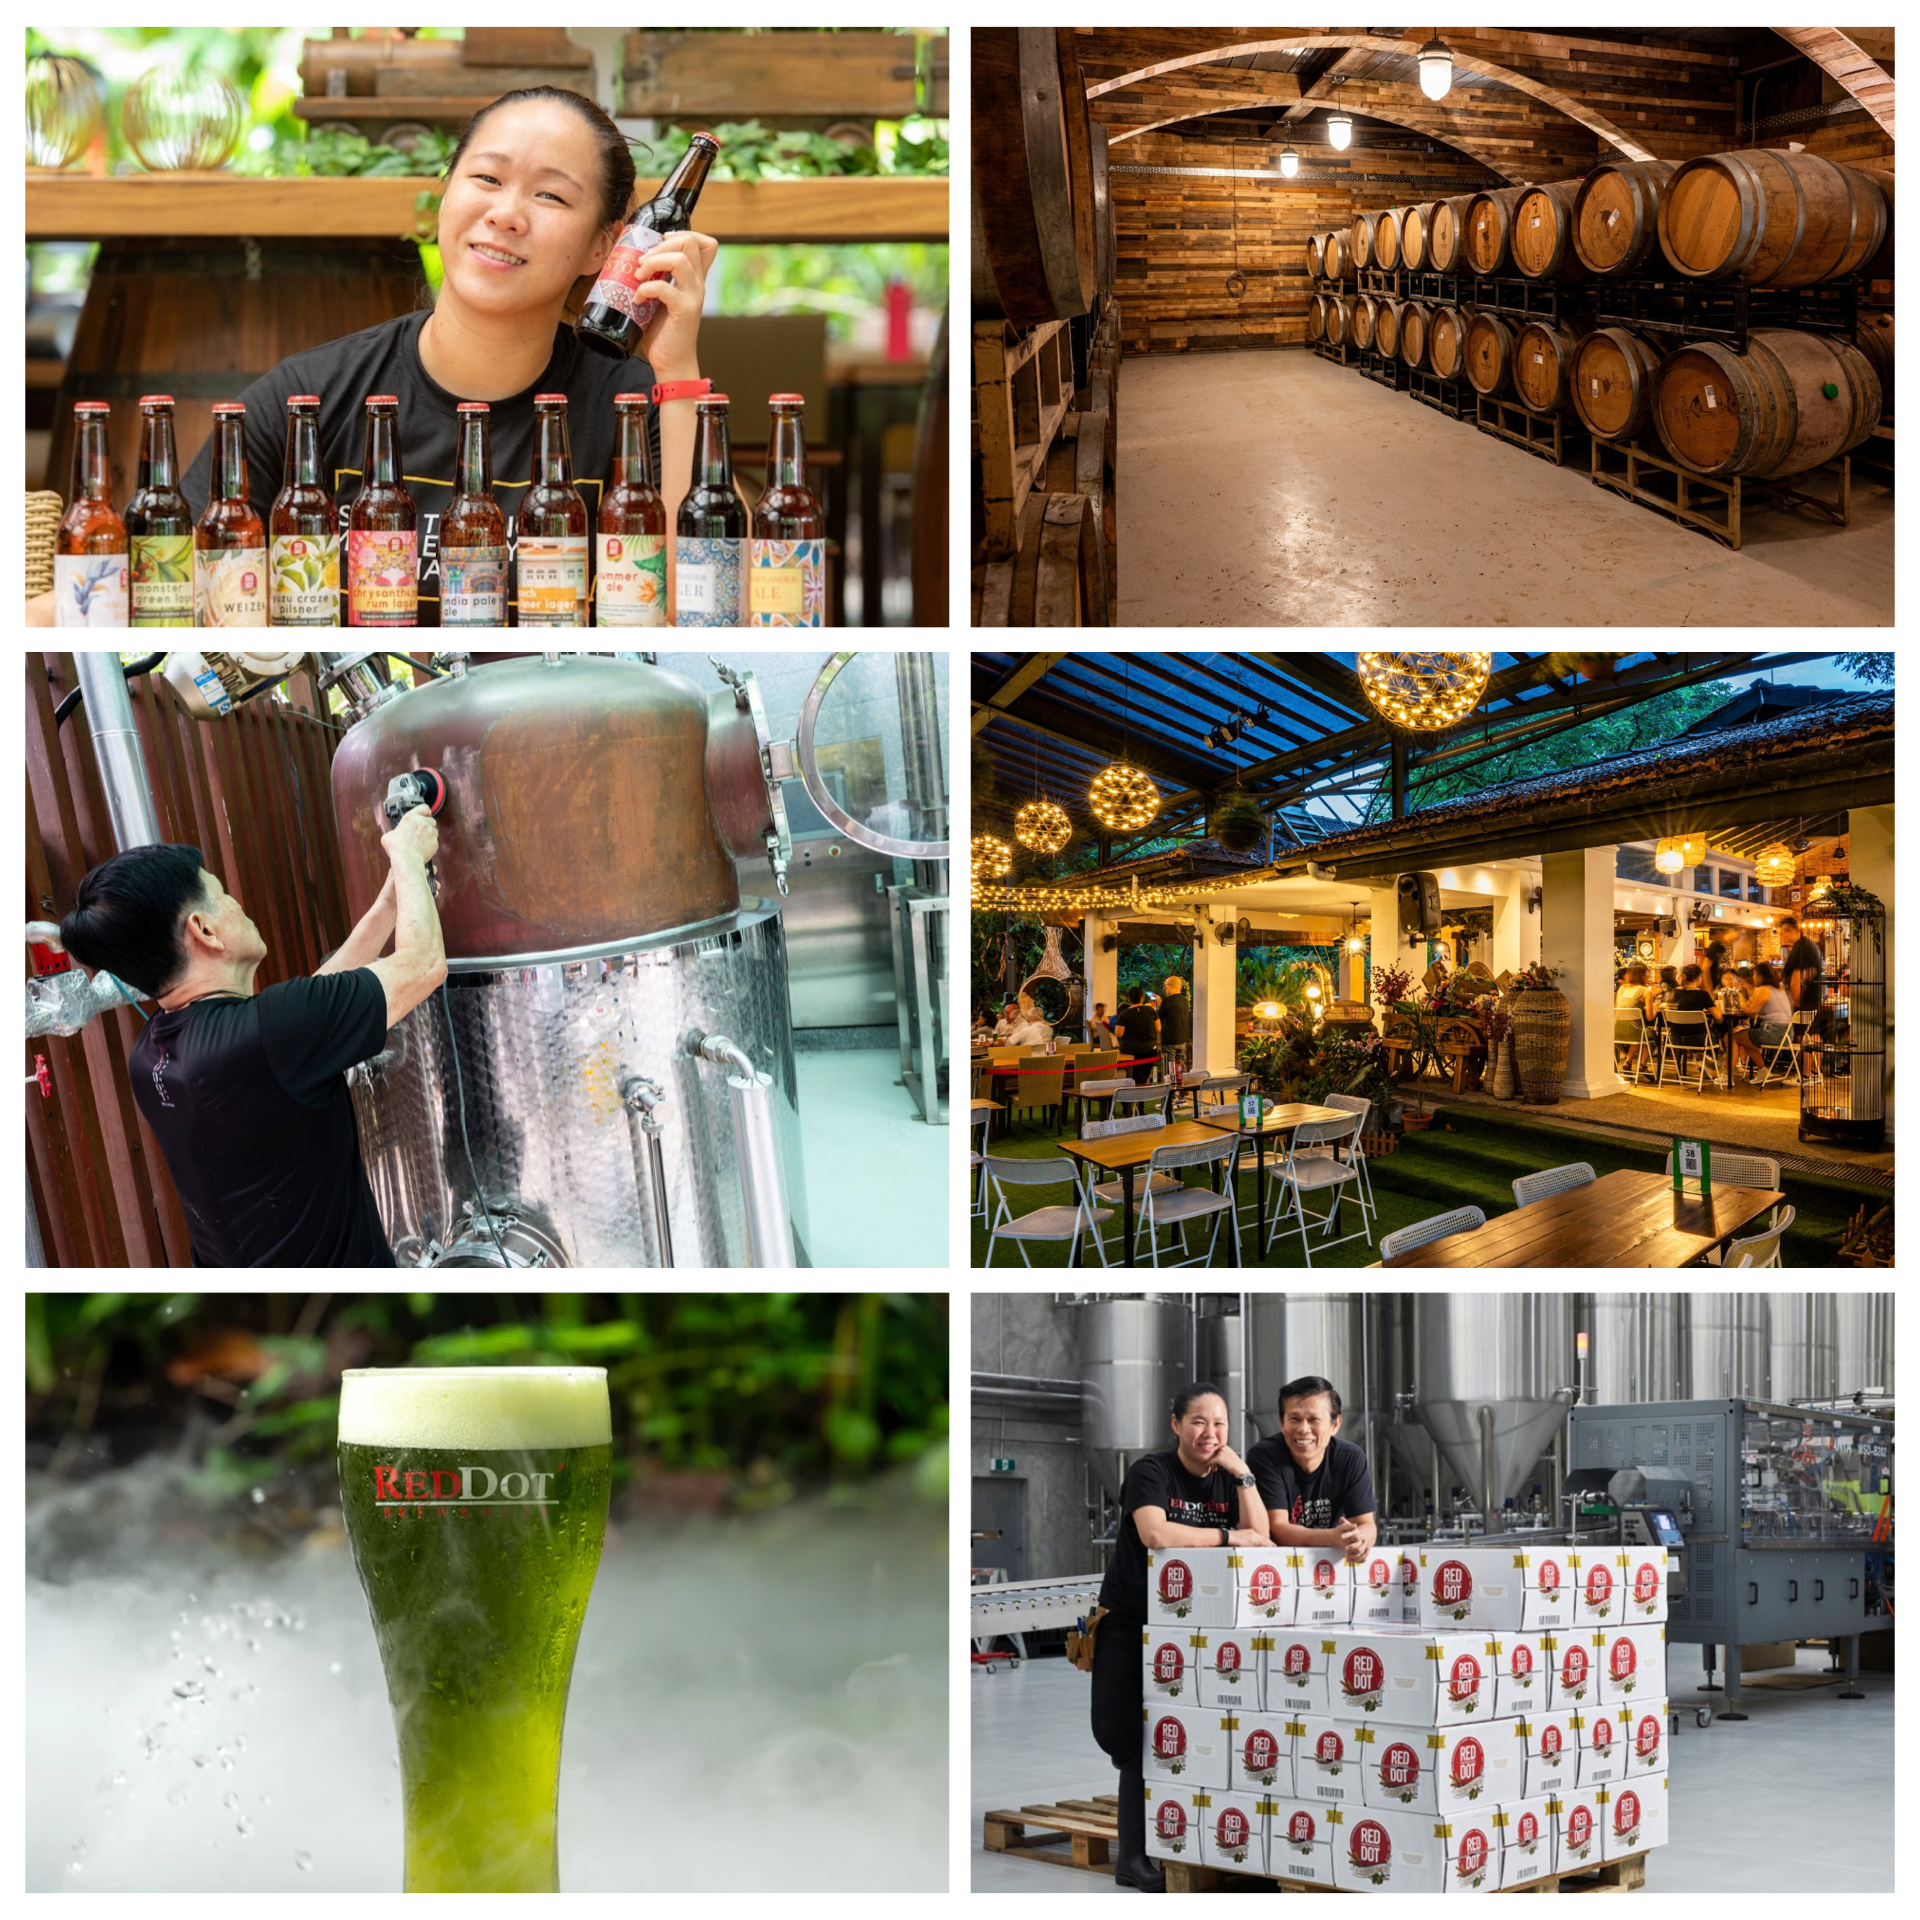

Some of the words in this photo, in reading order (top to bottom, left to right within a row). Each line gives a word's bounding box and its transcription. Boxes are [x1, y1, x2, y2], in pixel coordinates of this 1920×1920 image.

[136, 584, 182, 593] monster
[606, 581, 623, 592] ale
[136, 595, 171, 605] green
[297, 594, 329, 603] craze
[444, 595, 468, 606] india
[473, 595, 497, 607] pale
[544, 597, 575, 612] lager
[280, 604, 318, 615] pilsner
[444, 606, 458, 617] ale
[1686, 1149, 1696, 1158] 58
[1168, 1568, 1184, 1582] RED
[1319, 1565, 1330, 1575] RED
[1374, 1565, 1384, 1574] RED
[1403, 1564, 1411, 1573] ED
[1544, 1565, 1554, 1576] RED
[1258, 1572, 1273, 1585] RED
[1319, 1575, 1329, 1585] DOT
[1374, 1575, 1384, 1584] DOT
[1403, 1574, 1411, 1583] OT
[1444, 1569, 1462, 1583] RED
[1545, 1577, 1554, 1586] DOT
[1594, 1572, 1606, 1585] RED
[1642, 1571, 1653, 1584] RED
[1168, 1585, 1183, 1598] DOT
[1258, 1587, 1273, 1600] DOT
[1444, 1586, 1462, 1600] DOT
[1593, 1587, 1606, 1599] DOT
[1641, 1586, 1652, 1597] DOT
[1161, 1649, 1176, 1663] RED
[1223, 1647, 1235, 1658] RED
[1291, 1650, 1304, 1661] RED
[1517, 1650, 1527, 1661] RED
[1617, 1645, 1630, 1659] RED
[1223, 1659, 1234, 1669] DOT
[1354, 1656, 1373, 1671] RED
[1570, 1653, 1582, 1666] RED
[1161, 1665, 1175, 1679] DOT
[1291, 1662, 1303, 1673] DOT
[1459, 1662, 1473, 1676] RED
[1517, 1662, 1527, 1673] DOT
[1617, 1661, 1630, 1674] DOT
[1354, 1674, 1372, 1690] DOT
[1569, 1670, 1581, 1682] DOT
[1458, 1681, 1472, 1694] DOT
[1162, 1724, 1178, 1738] RED
[1598, 1723, 1607, 1735] RED
[1644, 1721, 1655, 1735] RED
[1324, 1737, 1336, 1748] RED
[1547, 1731, 1556, 1742] RED
[1163, 1740, 1178, 1754] DOT
[1254, 1737, 1270, 1751] RED
[1643, 1737, 1654, 1750] DOT
[1323, 1750, 1335, 1760] DOT
[1391, 1751, 1409, 1765] RED
[1460, 1745, 1476, 1761] RED
[1253, 1754, 1268, 1767] DOT
[1390, 1768, 1408, 1783] DOT
[1460, 1763, 1475, 1780] DOT
[1622, 1798, 1634, 1812] RED
[1164, 1806, 1179, 1819] RED
[1225, 1815, 1241, 1829] RED
[1295, 1817, 1308, 1827] RED
[1523, 1818, 1533, 1829] RED
[1575, 1813, 1587, 1826] RED
[1621, 1814, 1633, 1829] DOT
[1164, 1823, 1178, 1835] DOT
[1295, 1829, 1308, 1839] DOT
[1524, 1830, 1533, 1841] DOT
[1574, 1829, 1586, 1842] DOT
[1225, 1830, 1240, 1844] DOT
[1361, 1829, 1380, 1844] RED
[1467, 1836, 1481, 1851] RED
[1361, 1847, 1380, 1863] DOT
[1466, 1855, 1480, 1870] DOT
